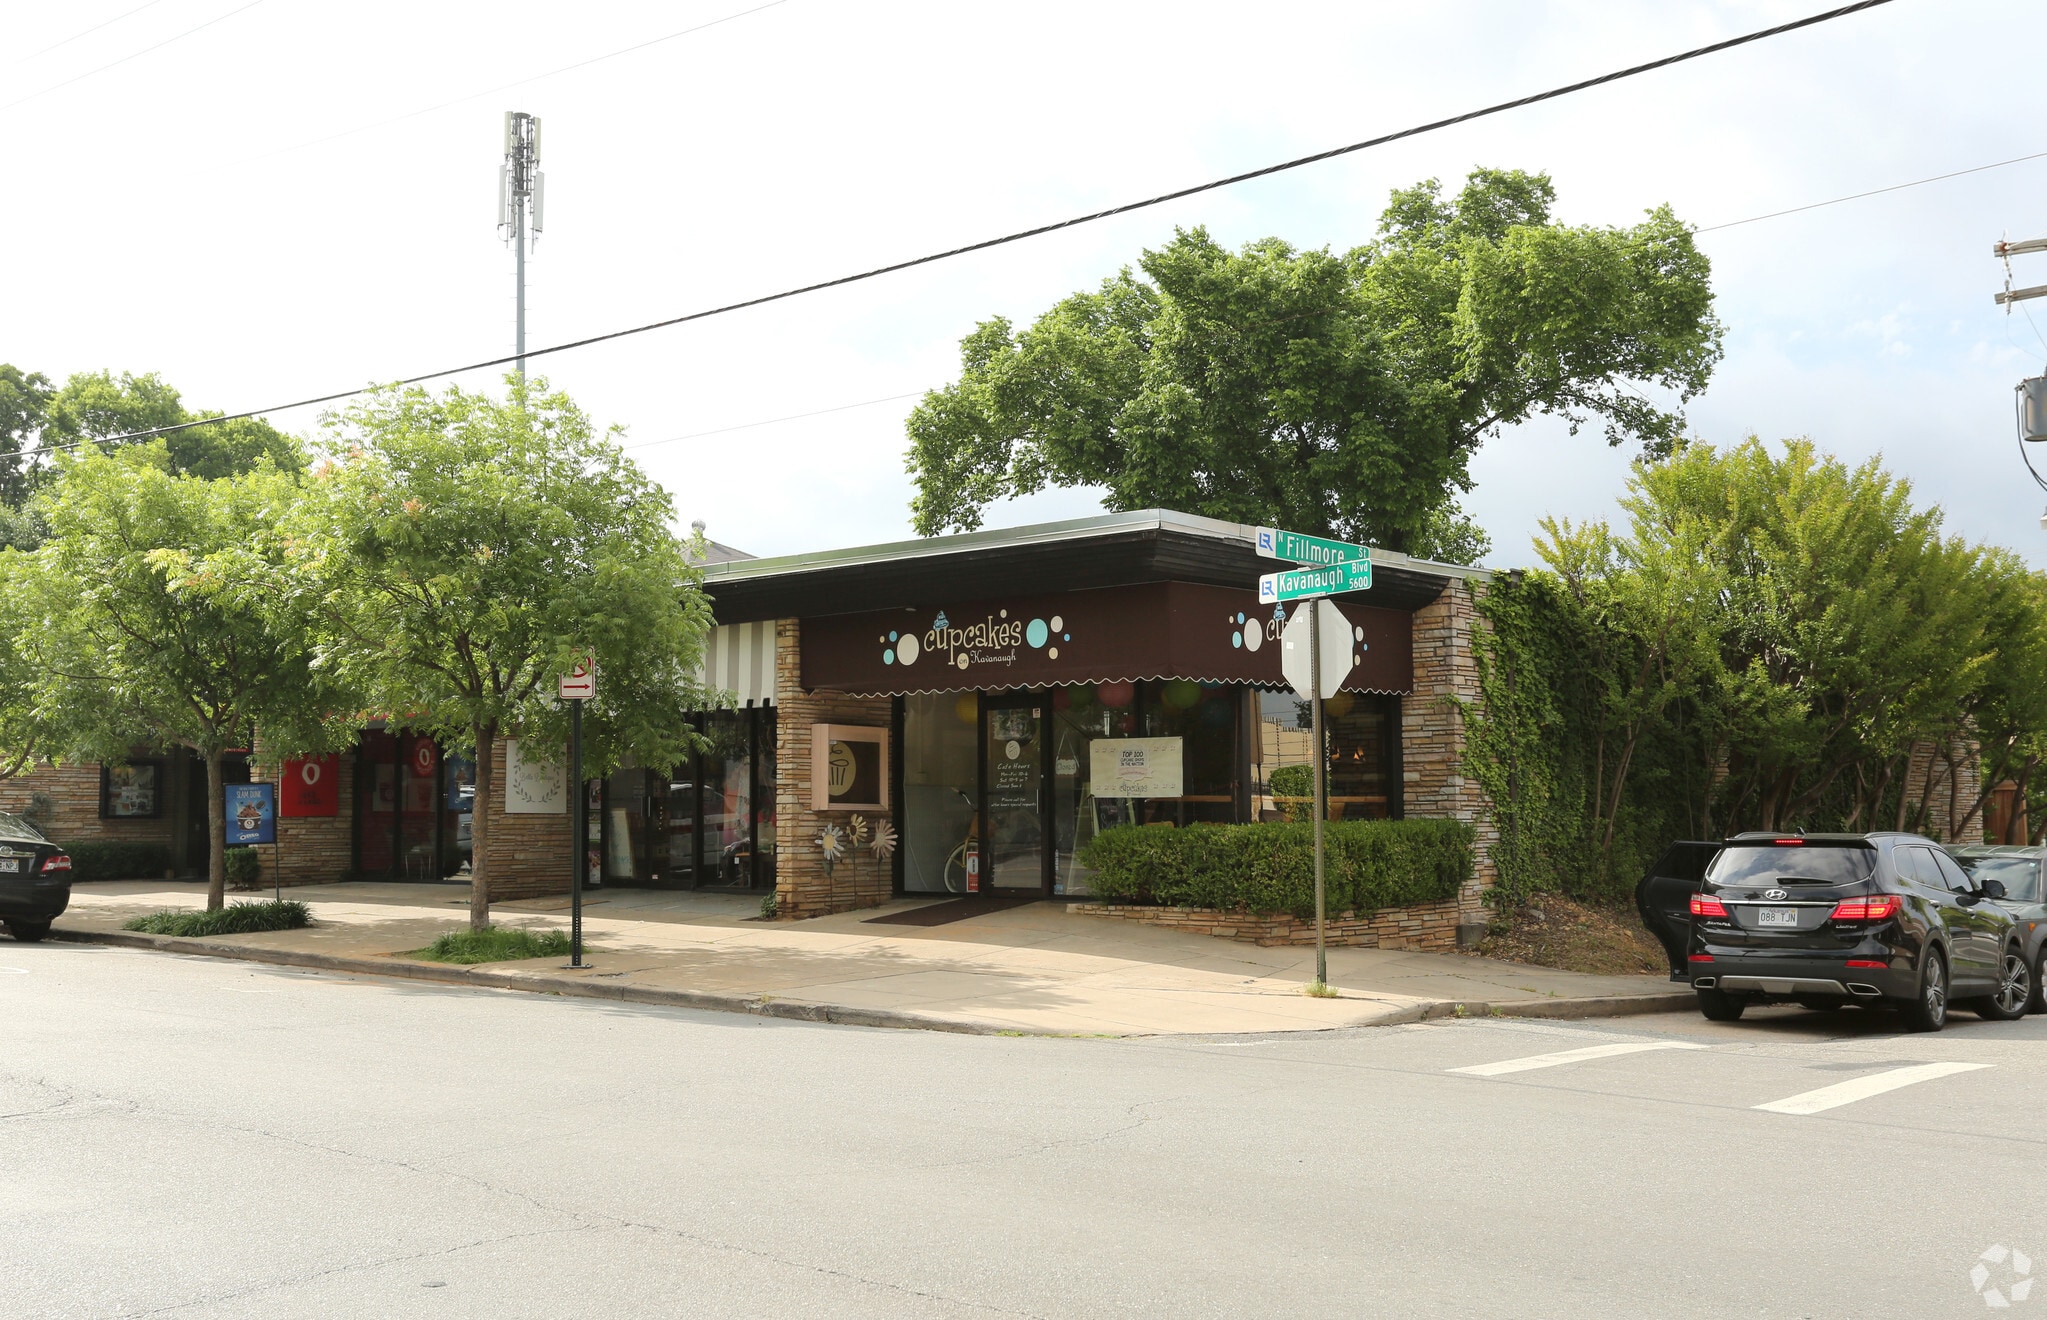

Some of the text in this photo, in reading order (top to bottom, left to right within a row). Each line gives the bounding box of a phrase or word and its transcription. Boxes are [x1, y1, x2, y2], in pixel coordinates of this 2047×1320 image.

[1278, 531, 1367, 565] N Fillmore St
[1279, 562, 1368, 593] Kavanaugh Blvd
[1349, 576, 1368, 590] 5600
[923, 615, 1022, 666] cupcakes
[970, 648, 1017, 667] Kavanaugh
[1760, 912, 1796, 922] 088 TJN
